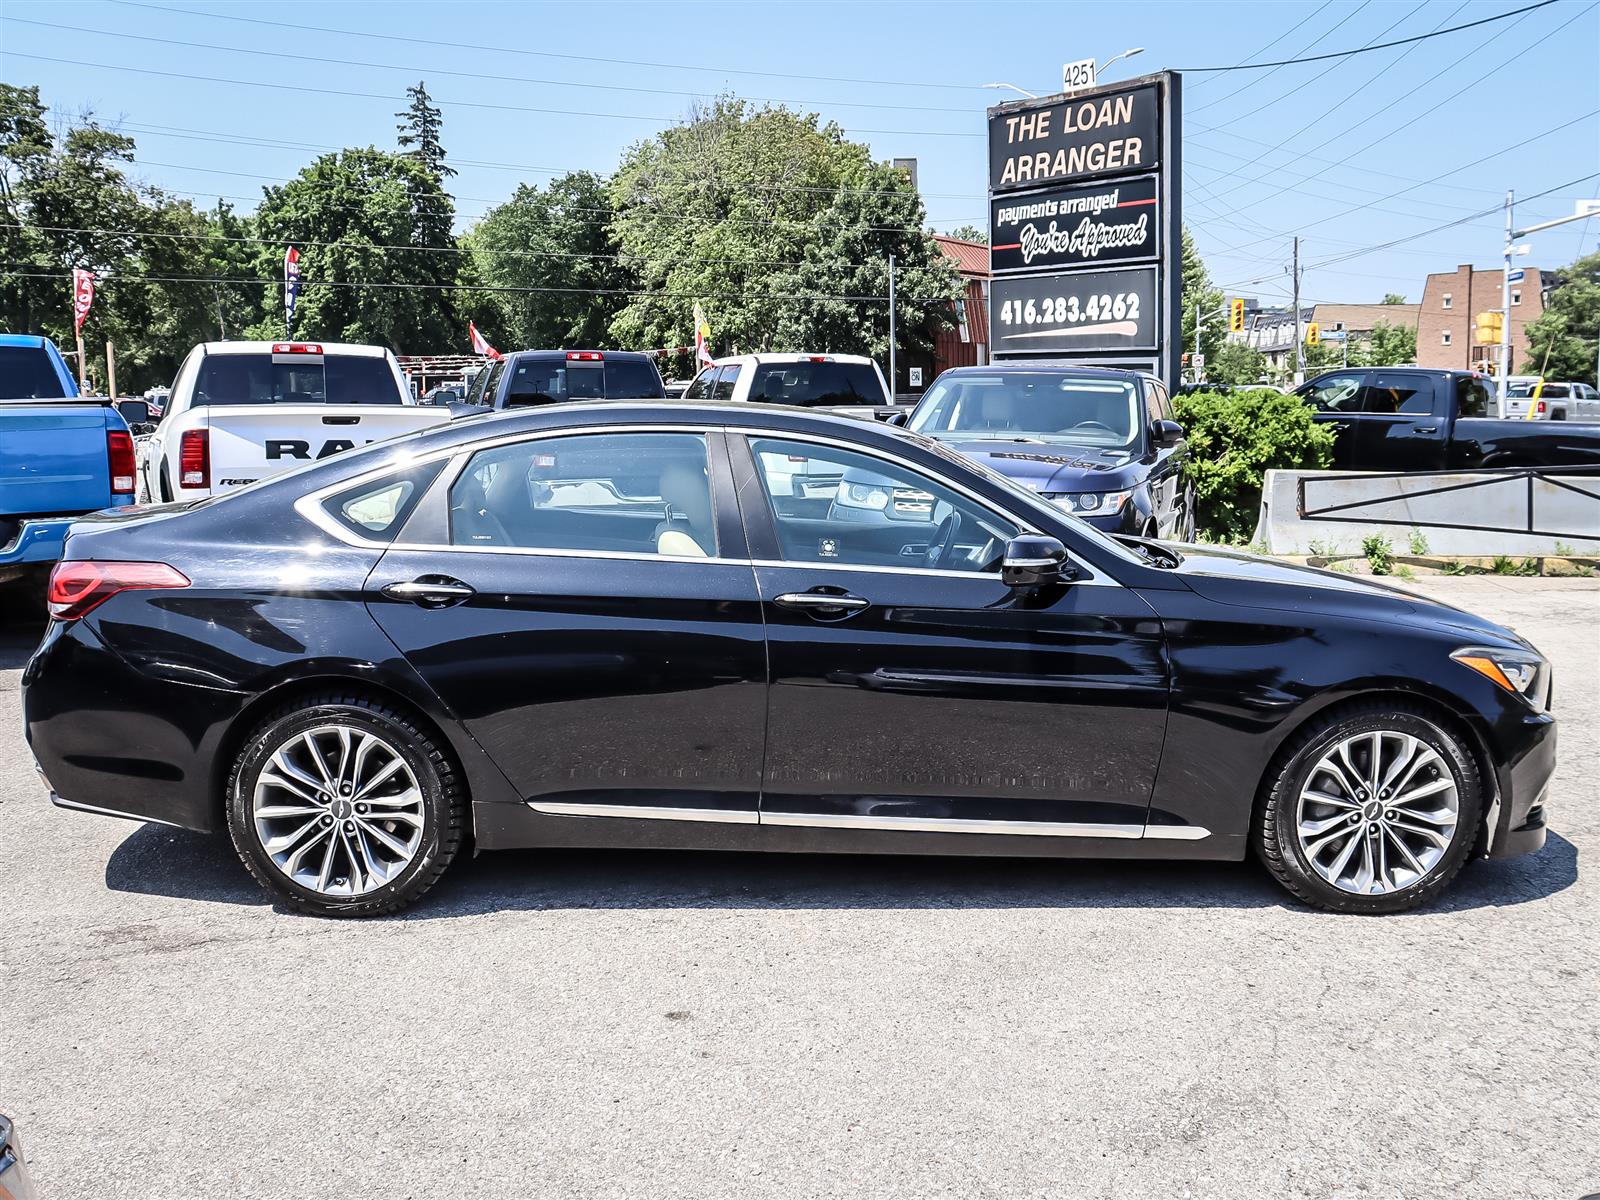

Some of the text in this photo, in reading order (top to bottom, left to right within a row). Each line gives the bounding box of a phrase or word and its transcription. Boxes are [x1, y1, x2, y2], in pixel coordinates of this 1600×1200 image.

[1064, 61, 1095, 87] 4251
[1006, 95, 1134, 144] THE LOAN
[1000, 137, 1143, 184] ARRANGER
[997, 188, 1119, 227] payments arranged
[1020, 213, 1147, 264] You're Approved
[1000, 292, 1140, 325] 416.283.4262
[265, 439, 375, 460] RA
[219, 478, 260, 486] REB
